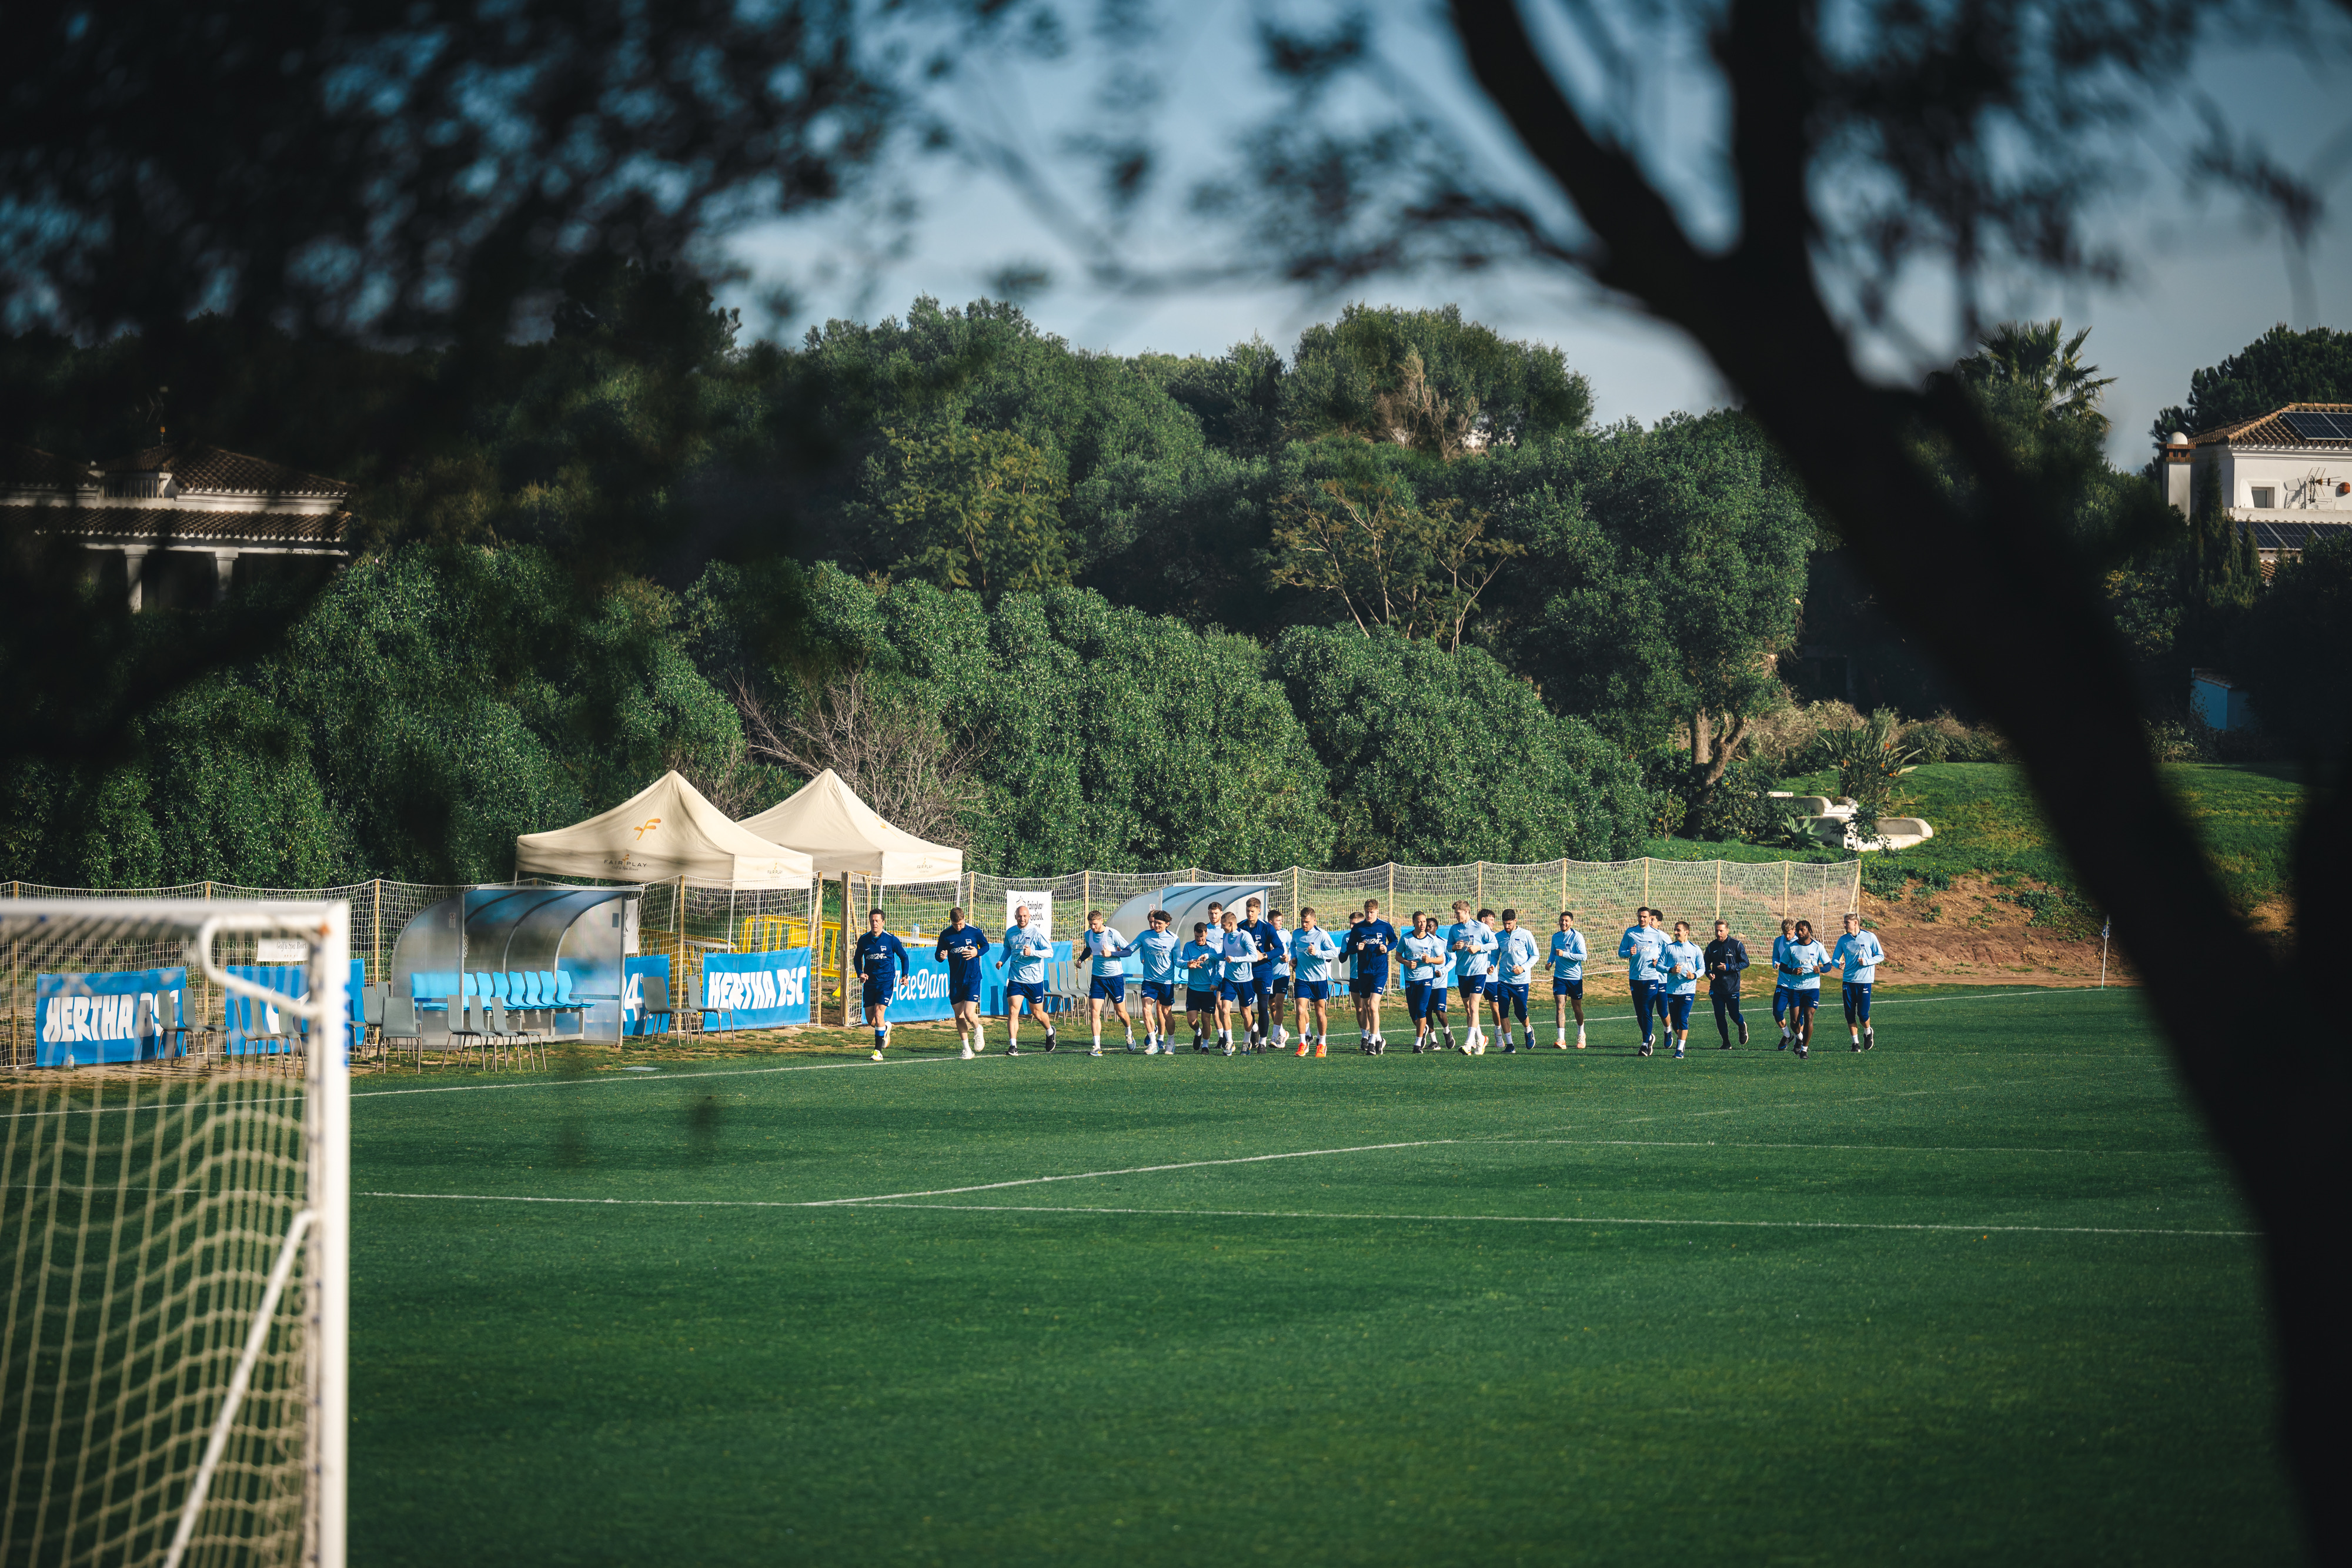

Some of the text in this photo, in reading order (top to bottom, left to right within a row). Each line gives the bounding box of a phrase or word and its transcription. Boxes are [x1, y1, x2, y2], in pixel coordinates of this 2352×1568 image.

[1030, 912, 1044, 921] ootball
[708, 966, 807, 1010] HERTHA BSC
[42, 994, 134, 1042] HERTHA
